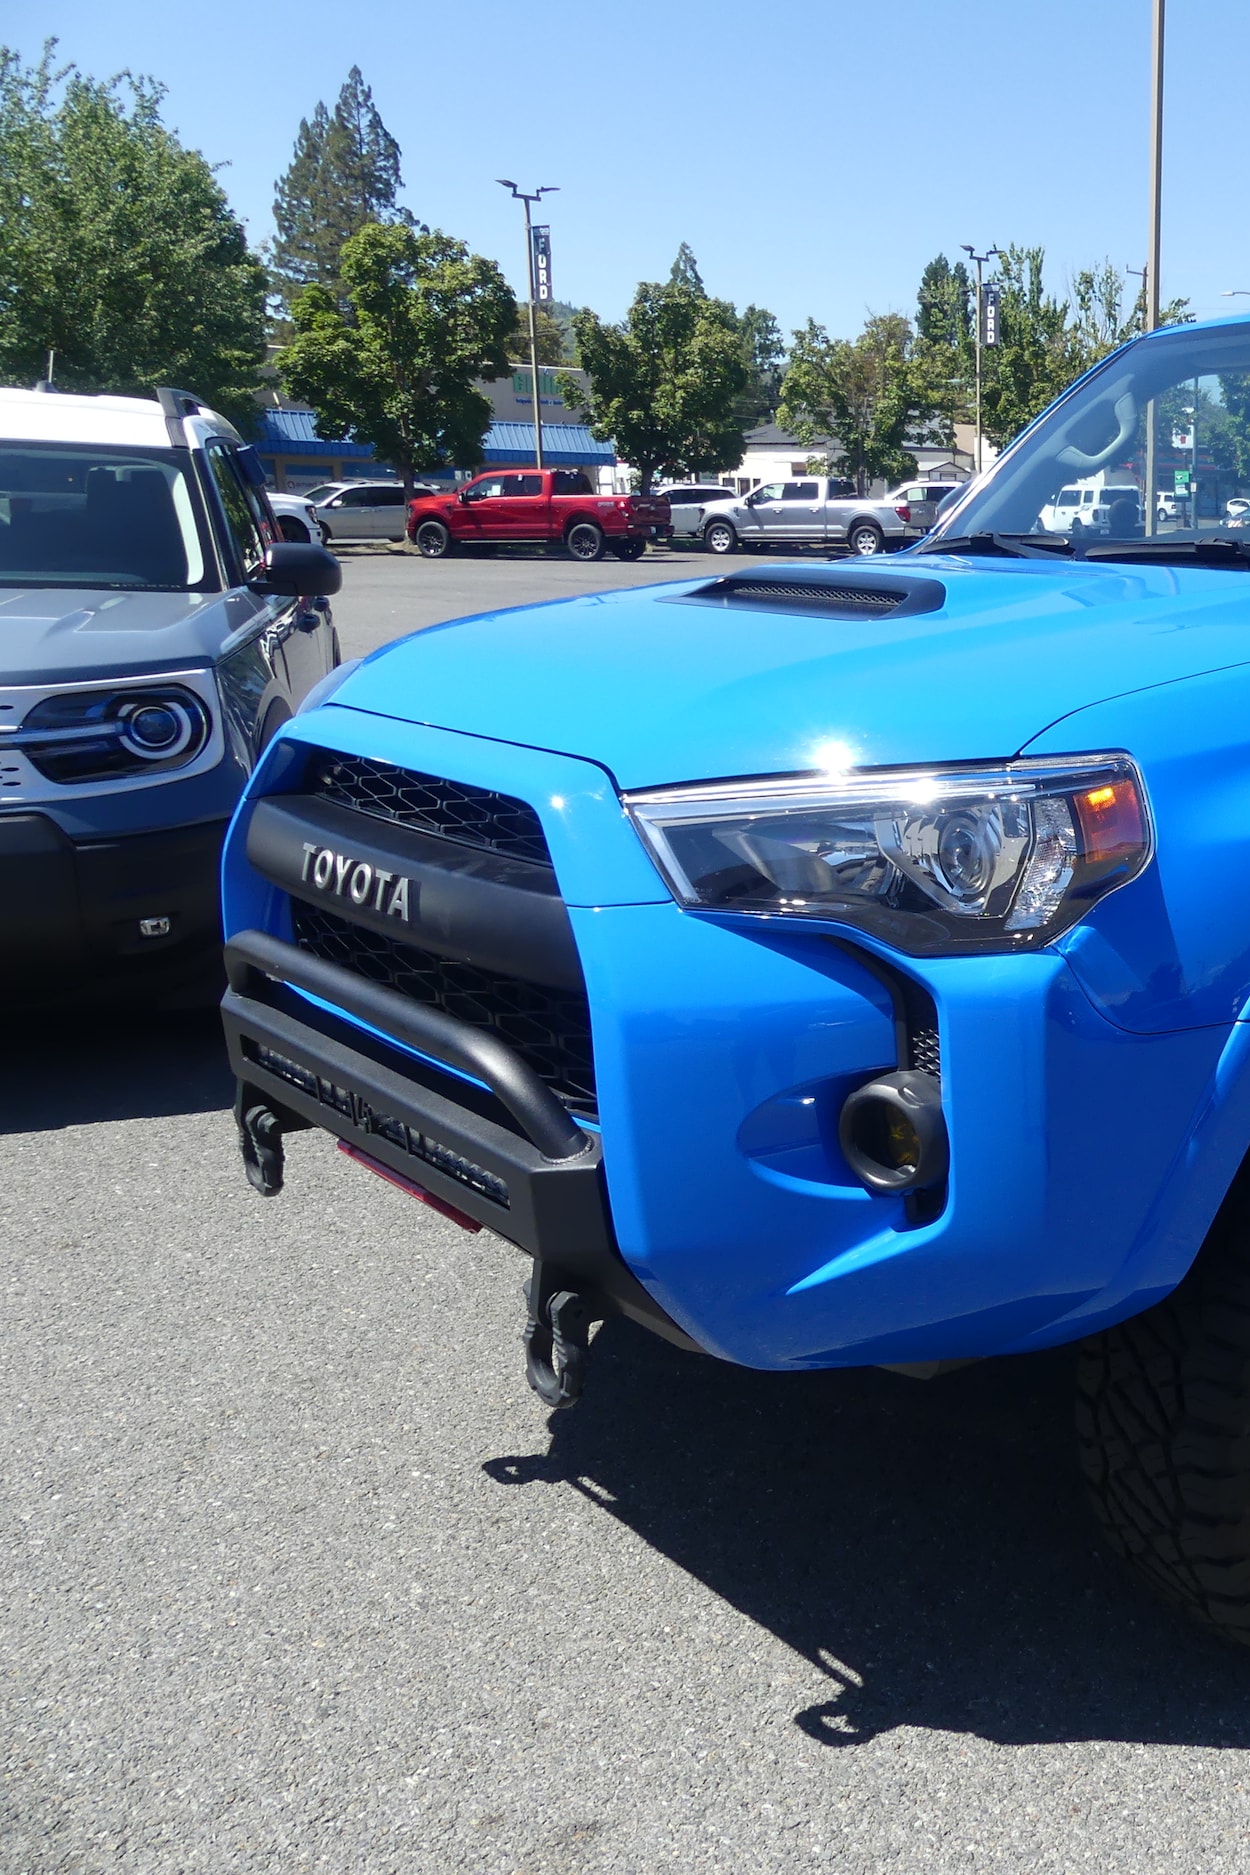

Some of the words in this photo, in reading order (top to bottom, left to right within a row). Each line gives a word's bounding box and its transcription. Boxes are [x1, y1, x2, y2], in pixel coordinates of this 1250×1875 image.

[538, 237, 548, 300] FORD
[986, 293, 996, 344] FORD
[301, 842, 410, 922] TOYOTA
